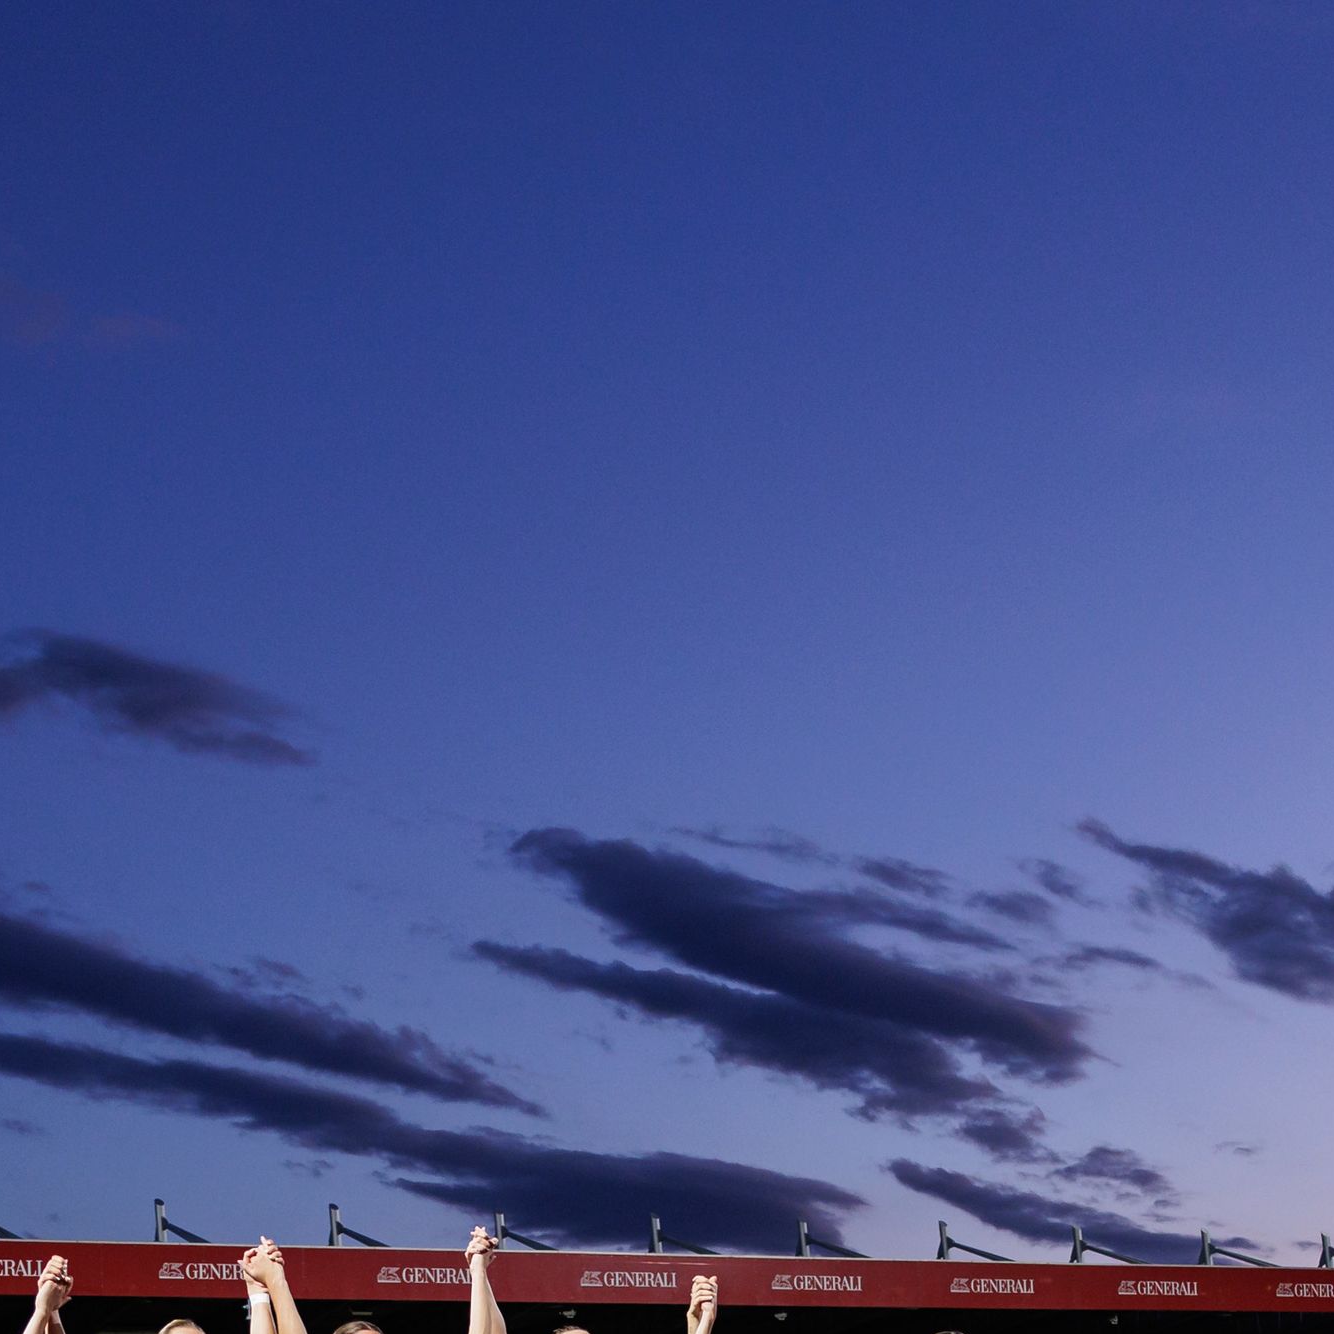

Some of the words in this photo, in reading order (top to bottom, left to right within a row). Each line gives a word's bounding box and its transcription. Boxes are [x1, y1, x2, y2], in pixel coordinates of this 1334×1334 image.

[603, 1271, 677, 1287] GENERALI
[793, 1275, 863, 1291] GENERALI
[970, 1278, 1035, 1294] GENERALI
[1137, 1280, 1199, 1296] GENERALI
